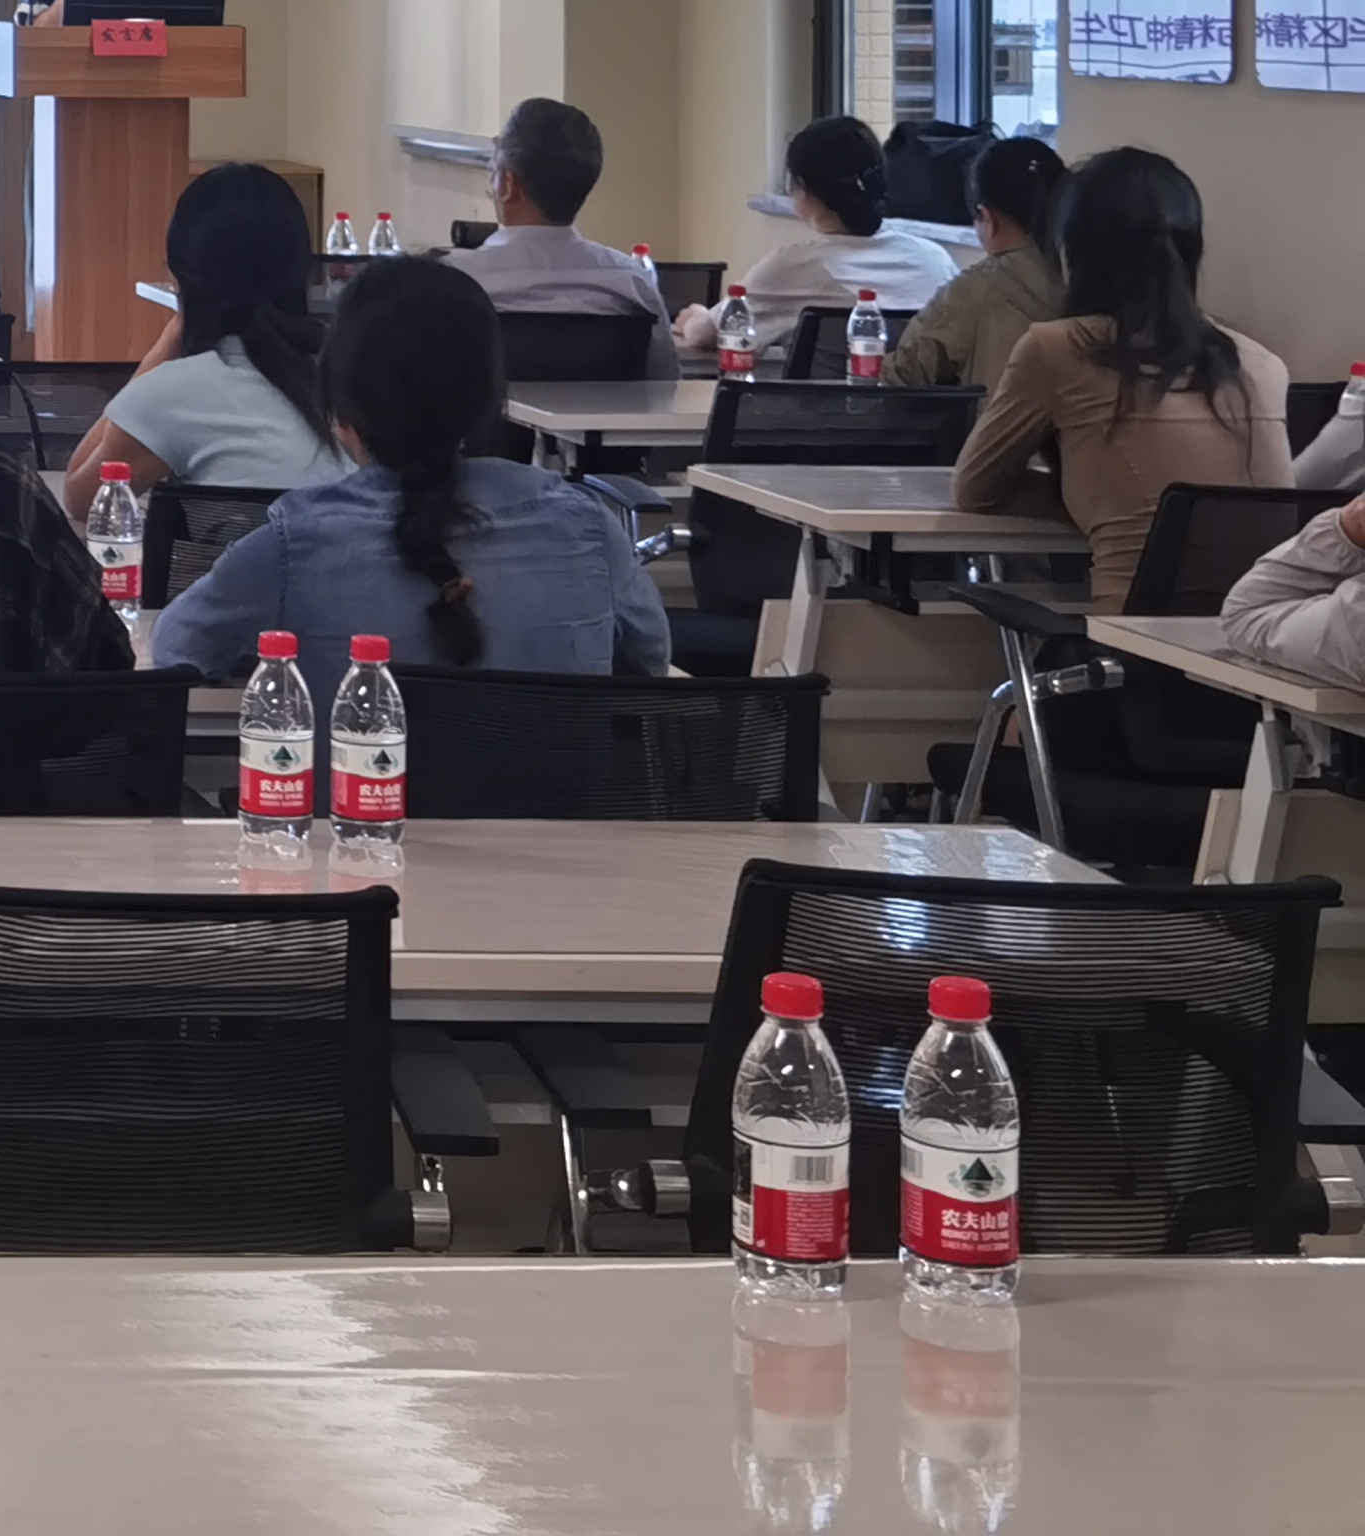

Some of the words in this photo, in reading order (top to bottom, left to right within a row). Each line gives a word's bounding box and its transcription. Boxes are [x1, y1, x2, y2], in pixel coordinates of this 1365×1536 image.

[101, 25, 154, 43] 发言席
[941, 1208, 1010, 1230] 农夫山泉
